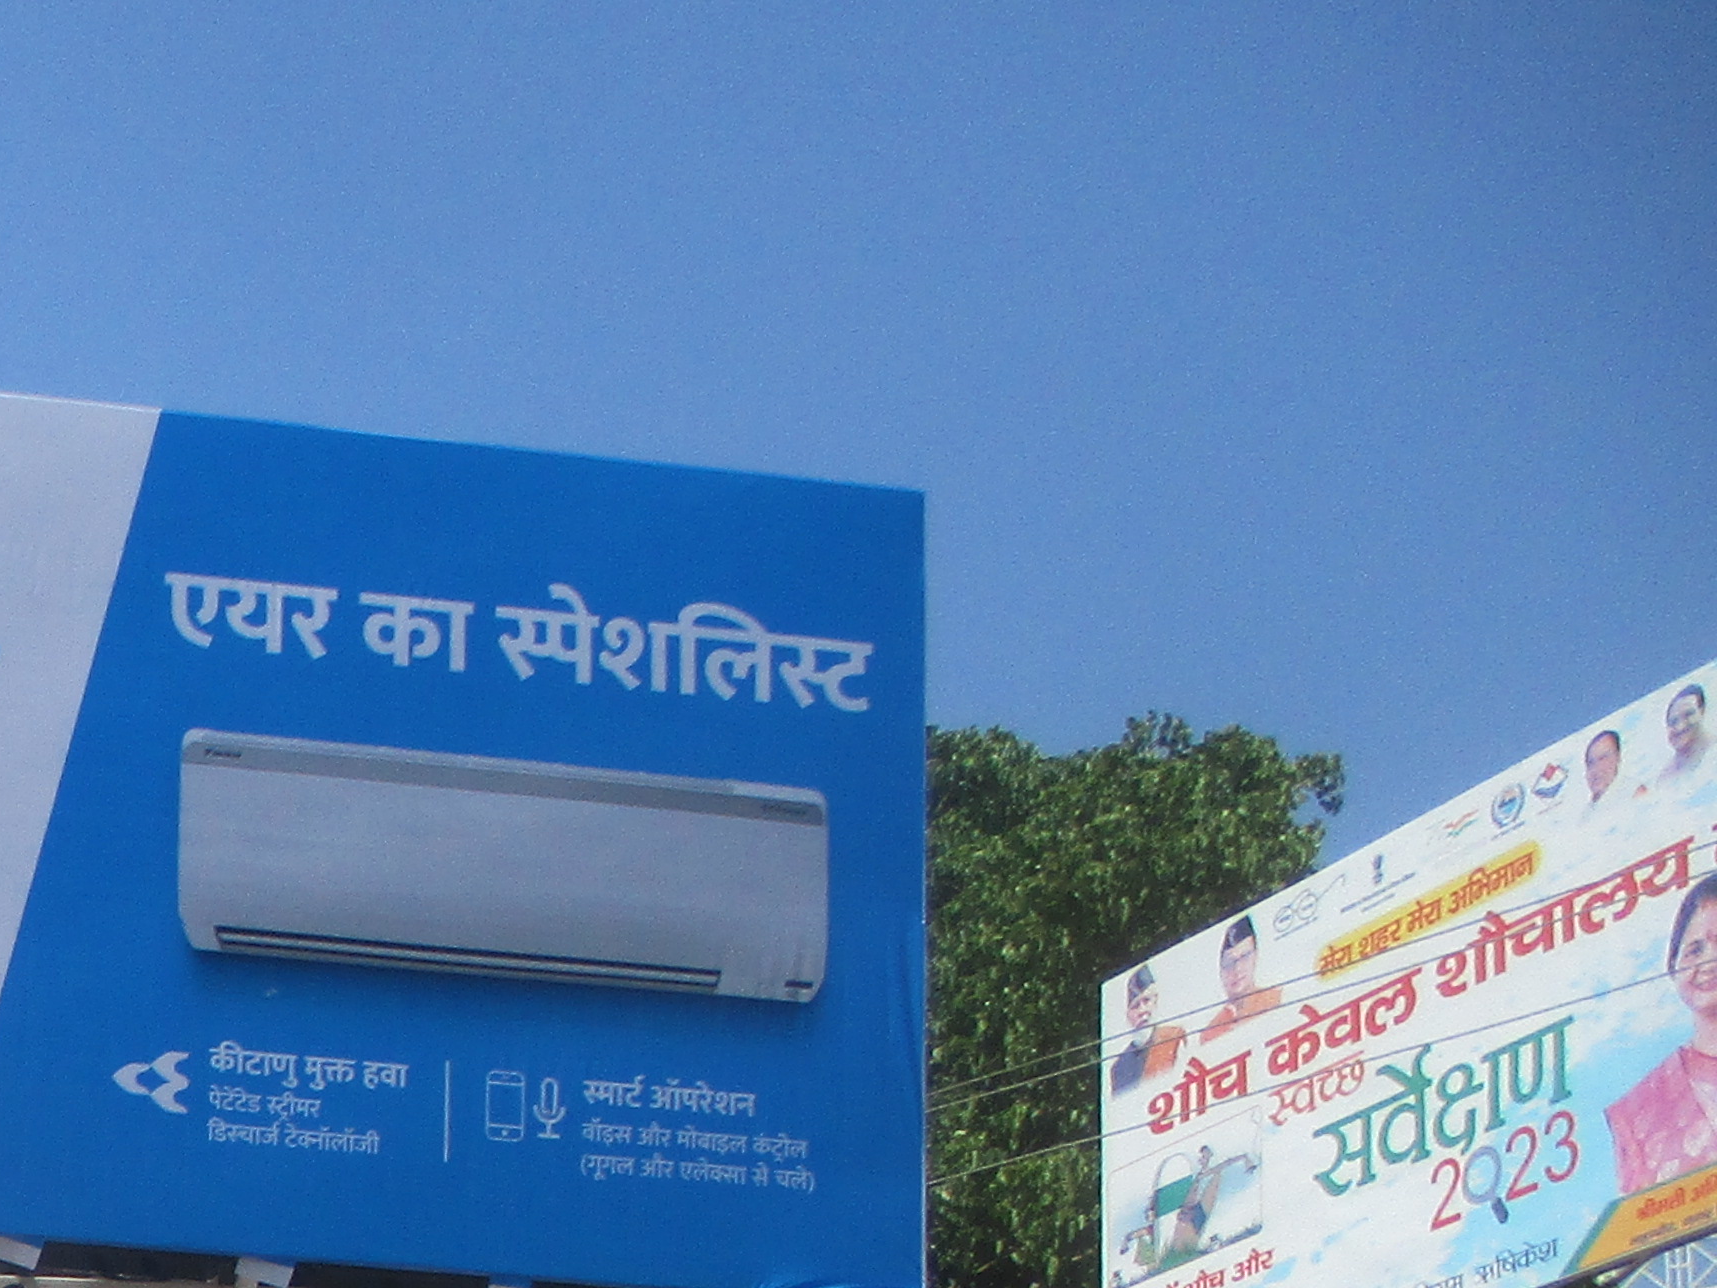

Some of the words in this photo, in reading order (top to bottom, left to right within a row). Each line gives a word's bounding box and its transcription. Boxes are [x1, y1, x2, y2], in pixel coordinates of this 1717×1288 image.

[165, 571, 339, 660] एयर
[360, 592, 473, 672] का
[495, 583, 873, 713] स्पेशलिस्ट
[1319, 942, 1352, 977] मेरा
[1358, 921, 1401, 961] शहर
[1406, 897, 1442, 936] मेरा
[1448, 850, 1535, 917] अभिमान
[1148, 1049, 1252, 1135] शौच
[1265, 968, 1422, 1077] केवल
[1435, 836, 1694, 998] शौचालय
[209, 1040, 299, 1089] कीटाणु
[304, 1055, 357, 1090] मुक्त
[362, 1061, 409, 1089] हवा
[583, 1074, 645, 1108] स्मार्ट
[650, 1078, 756, 1117] ऑपरेशन
[1269, 1051, 1365, 1125] स्वच्छ
[1313, 1015, 1575, 1195] सर्वेक्षण
[637, 1121, 672, 1148] और
[677, 1125, 747, 1155] मोबाइल
[640, 1153, 674, 1178] और
[1231, 1248, 1275, 1282] और
